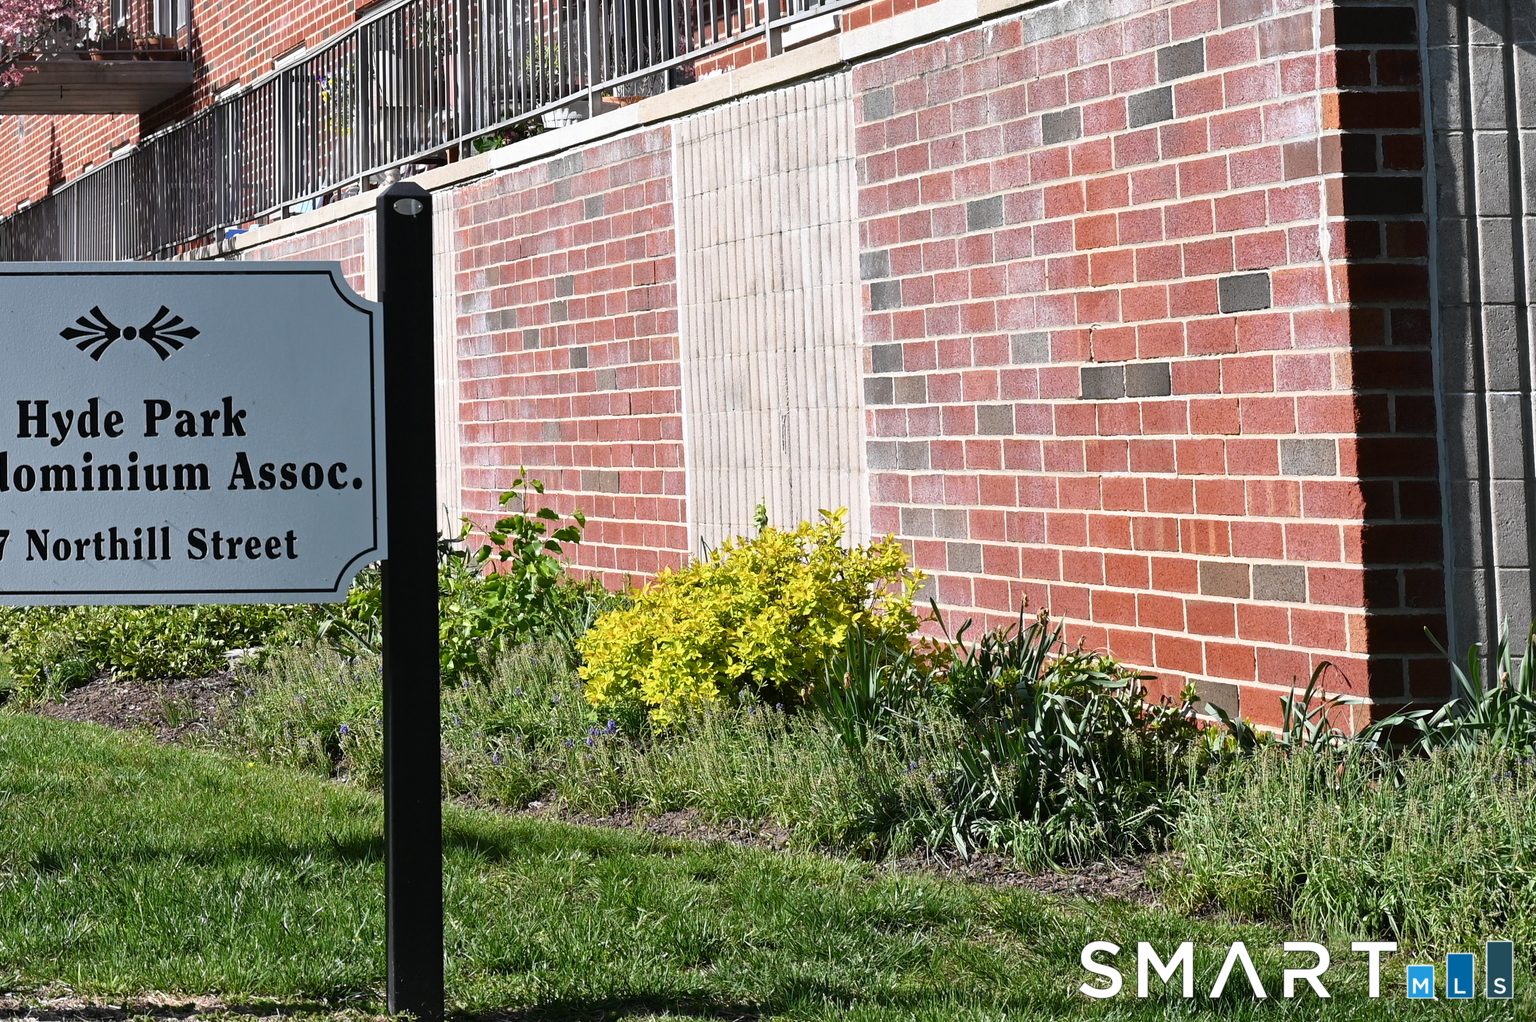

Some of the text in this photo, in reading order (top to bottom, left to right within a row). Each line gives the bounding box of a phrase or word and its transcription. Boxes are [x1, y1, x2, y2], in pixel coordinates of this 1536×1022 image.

[16, 396, 248, 447] Hyde Park
[227, 451, 364, 492] Assoc.
[25, 525, 173, 562] Northill
[186, 527, 300, 561] Street
